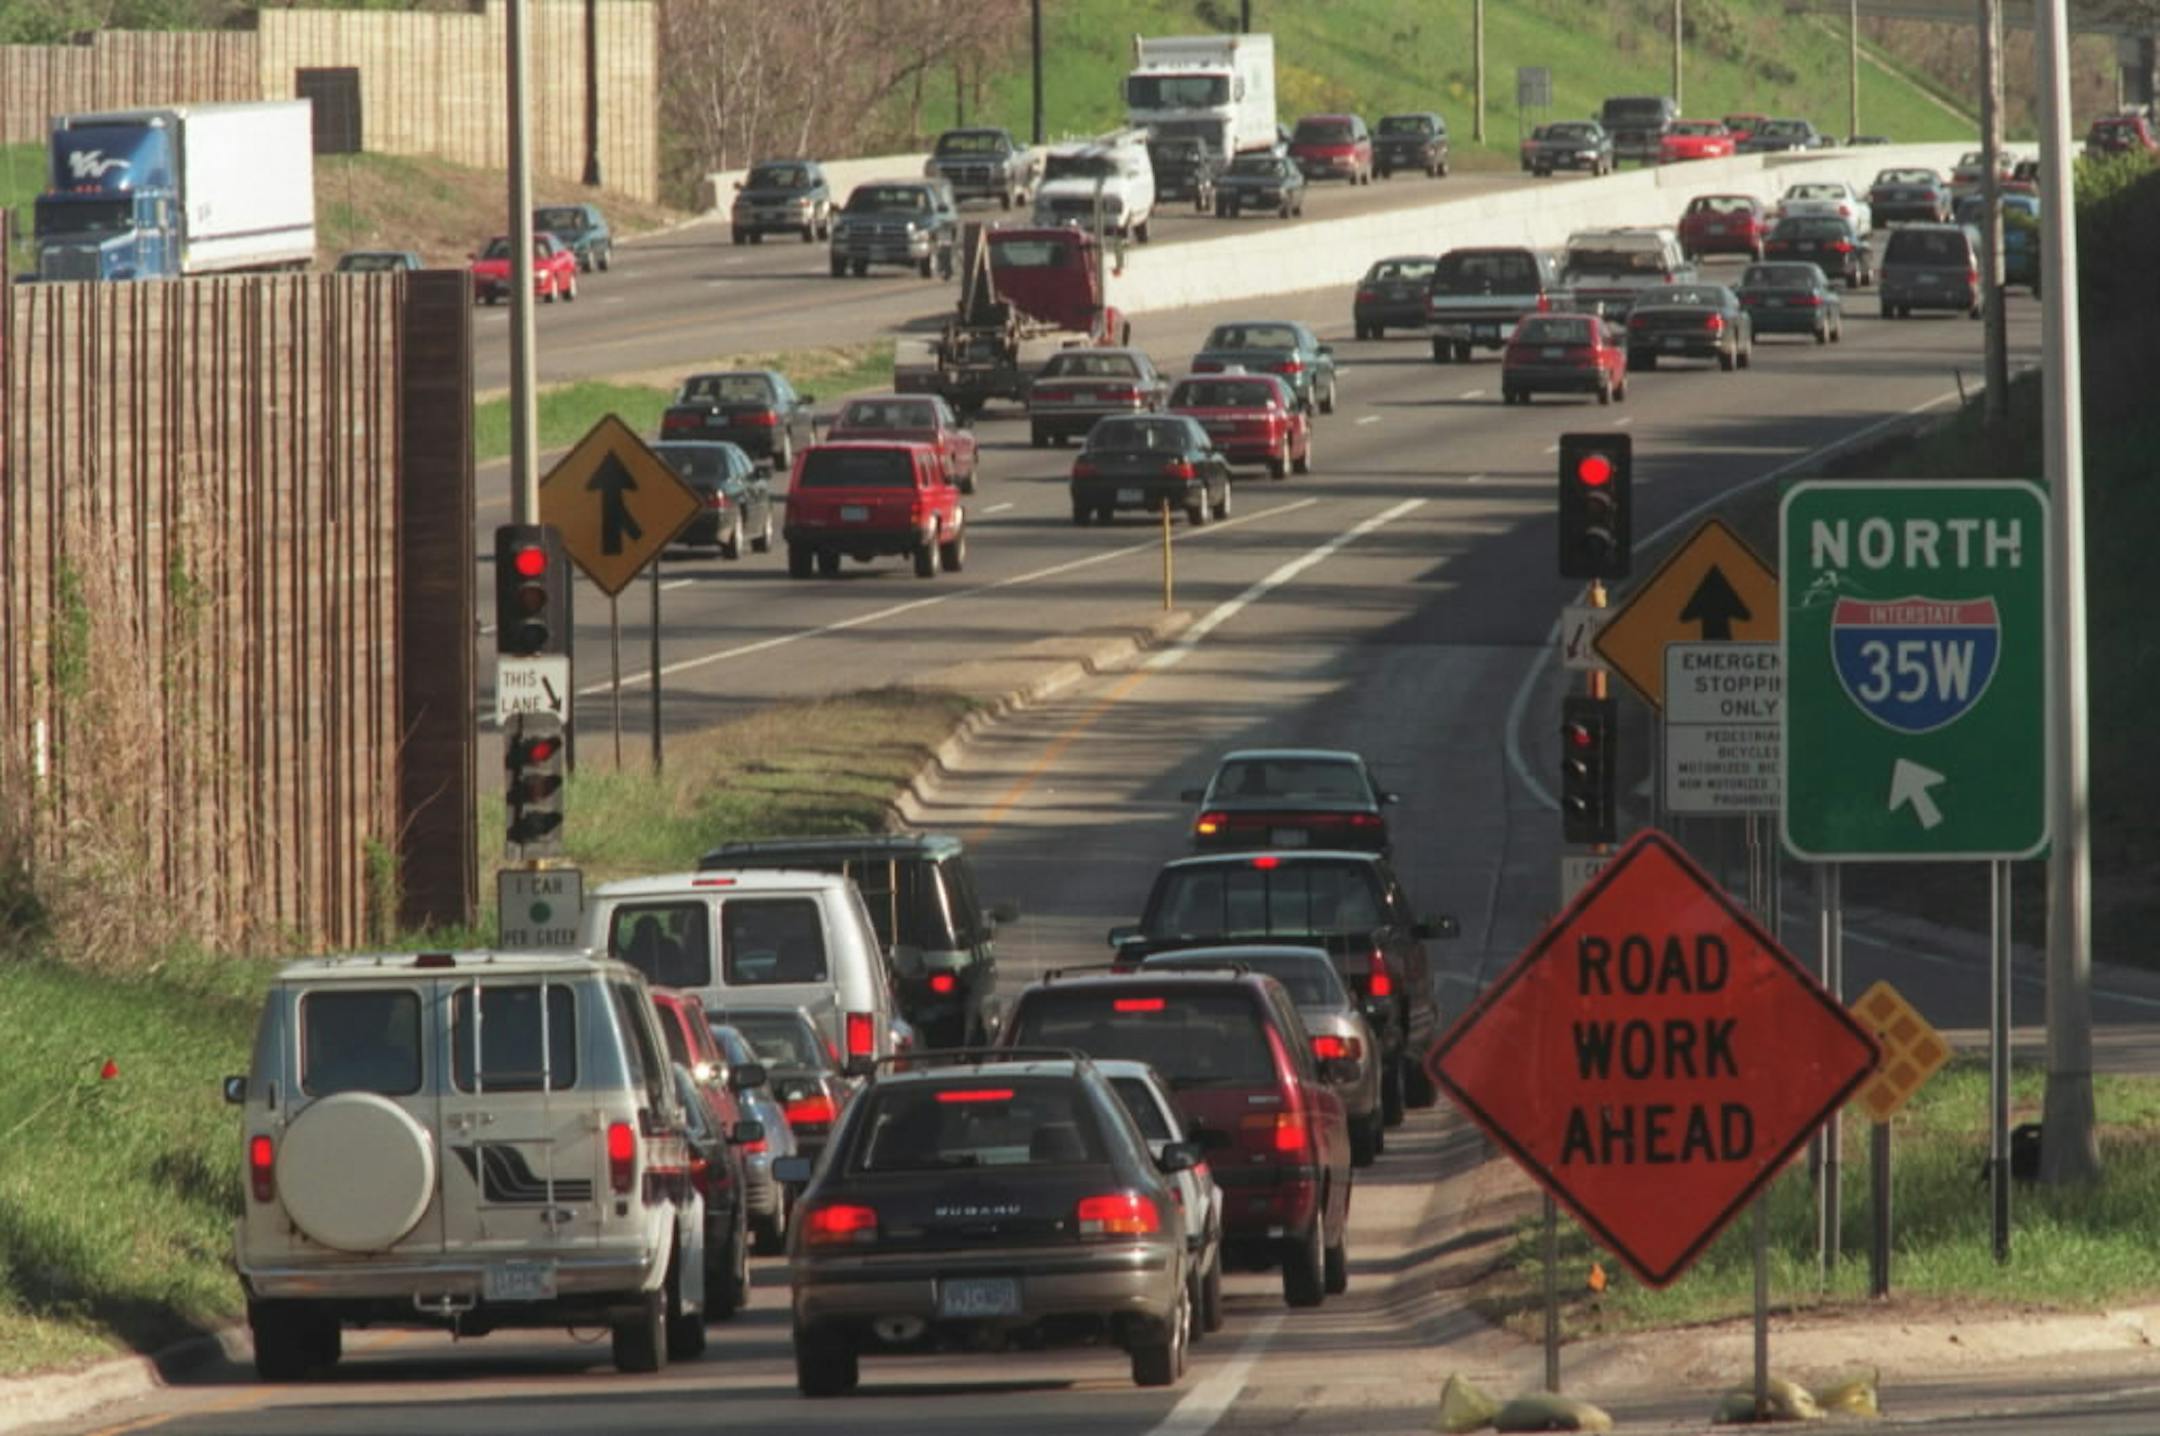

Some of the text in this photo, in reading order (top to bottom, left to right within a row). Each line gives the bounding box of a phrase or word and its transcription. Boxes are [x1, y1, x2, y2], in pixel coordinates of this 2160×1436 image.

[1811, 517, 2022, 568] NORTH
[1869, 606, 1961, 624] INTERSTATE
[503, 670, 537, 688] THIS
[1858, 640, 1976, 702] 35W
[502, 695, 541, 713] LANE
[1720, 699, 1779, 716] ONLY
[531, 877, 563, 895] CAR
[1578, 933, 1729, 996] ROAD
[1572, 1018, 1739, 1080] WORK
[1560, 1103, 1754, 1165] AHEAD
[935, 1204, 1021, 1216] SUBARU
